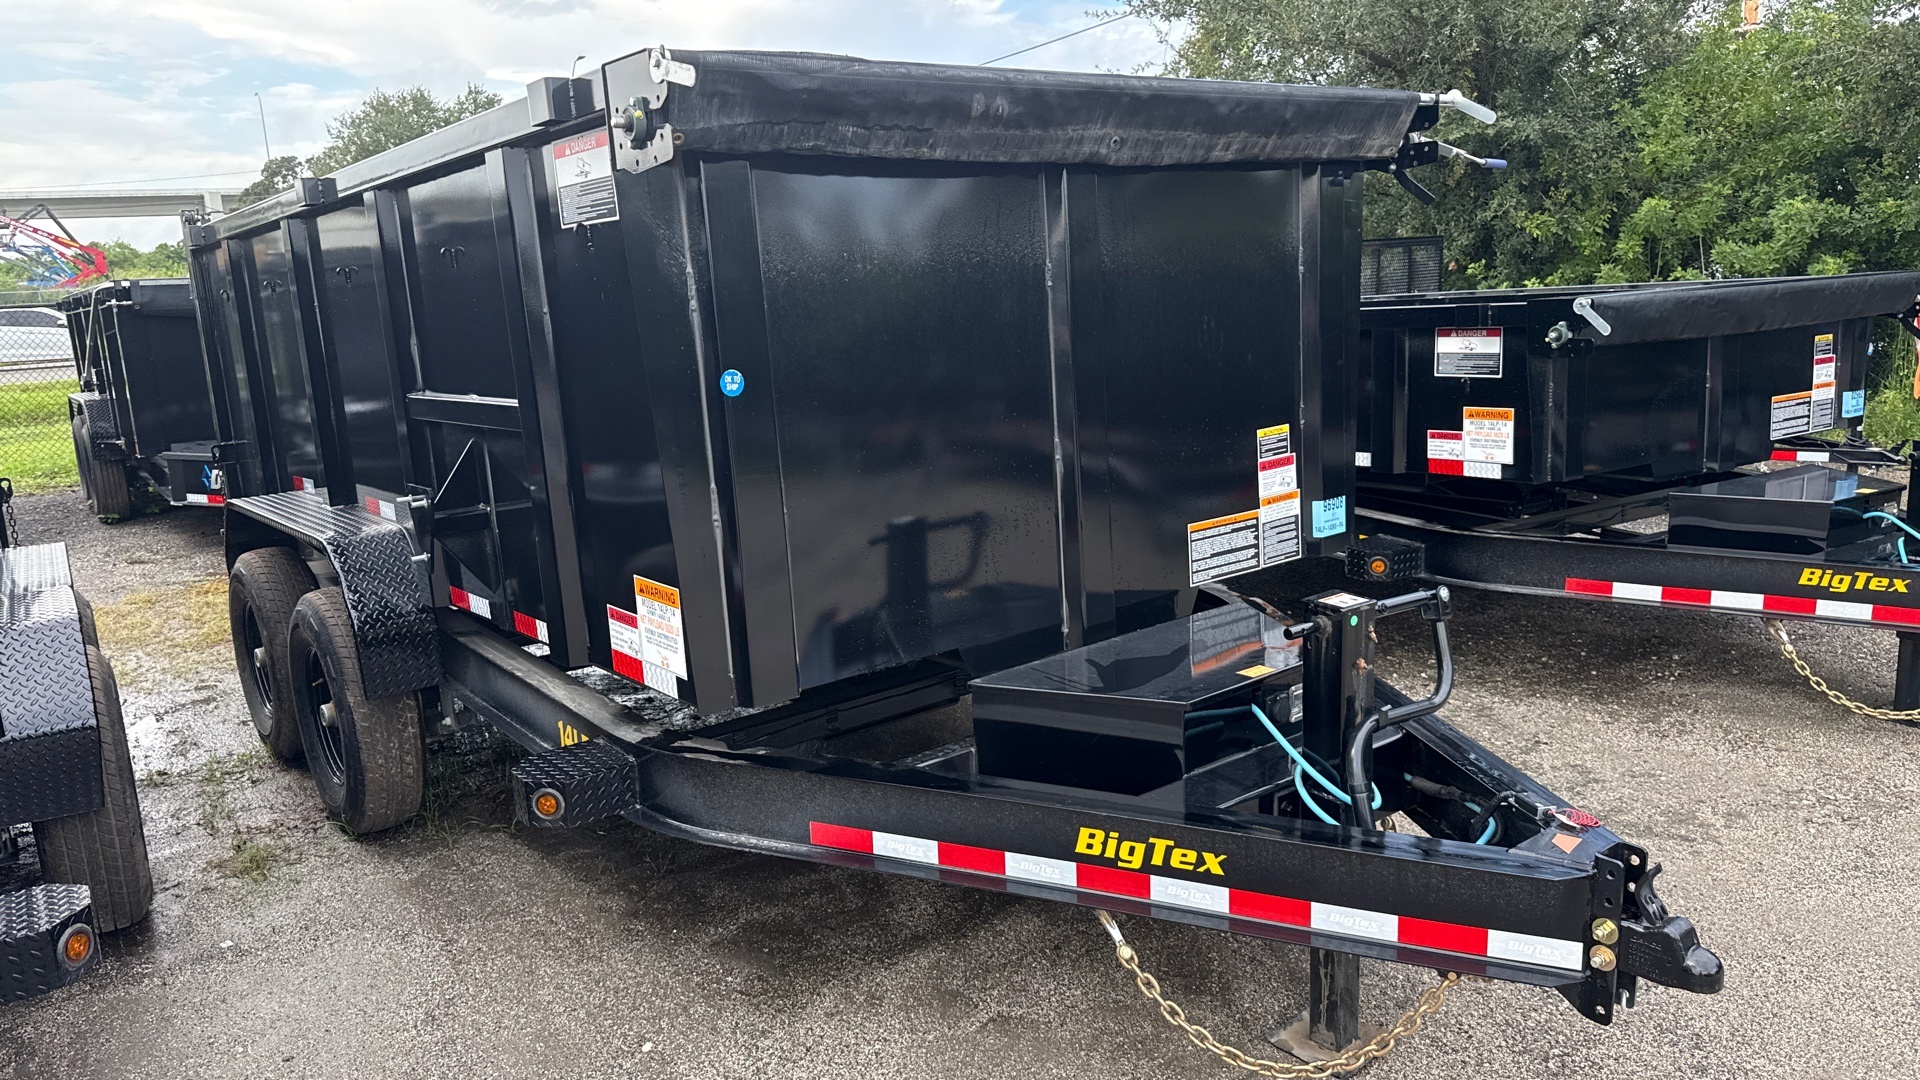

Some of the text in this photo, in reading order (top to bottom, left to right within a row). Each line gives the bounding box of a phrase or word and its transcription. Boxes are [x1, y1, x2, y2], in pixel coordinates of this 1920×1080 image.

[571, 137, 597, 154] DANGER
[724, 375, 741, 383] OK TO
[726, 383, 739, 391] SHIP
[1474, 410, 1509, 420] WARNING
[1268, 457, 1291, 469] DANGER
[1271, 493, 1294, 504] WARNING
[1323, 496, 1343, 512] 96908
[1798, 568, 1912, 593] BigTex
[643, 583, 676, 605] WARNING
[616, 611, 635, 625] DANGER
[886, 840, 924, 857] BigTex
[1074, 826, 1228, 876] BigTex
[1020, 861, 1061, 876] BigTex
[1167, 885, 1212, 902] BigTex
[1328, 912, 1379, 929] BigTex
[1507, 940, 1561, 957] BigTex
